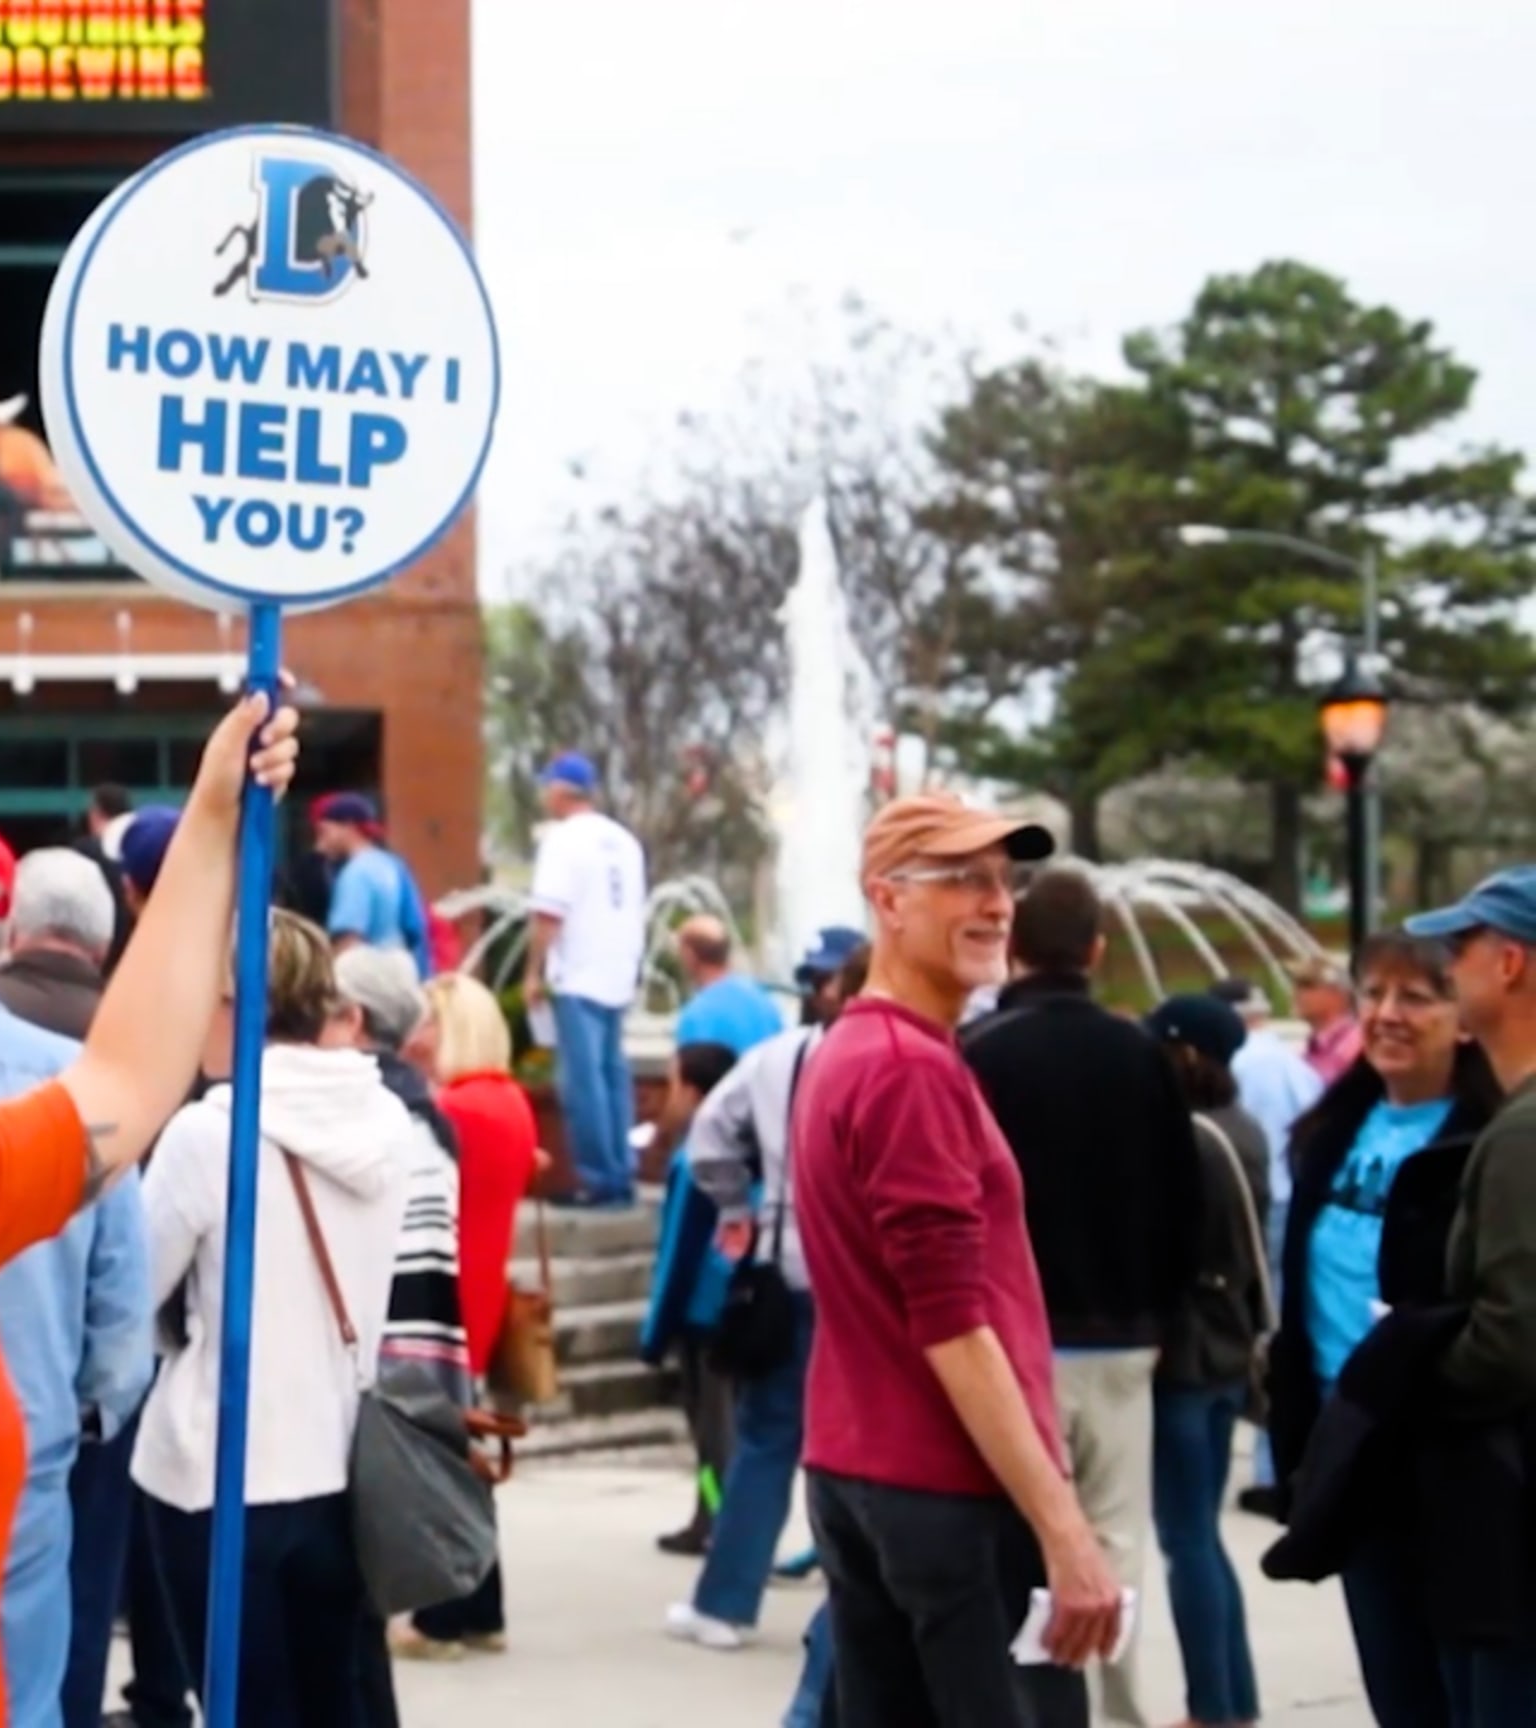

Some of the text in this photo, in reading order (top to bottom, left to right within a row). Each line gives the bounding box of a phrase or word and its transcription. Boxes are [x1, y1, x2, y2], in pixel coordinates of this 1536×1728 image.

[107, 322, 461, 403] HOW MAY I
[158, 394, 408, 489] HELP
[192, 494, 367, 556] YOU?
